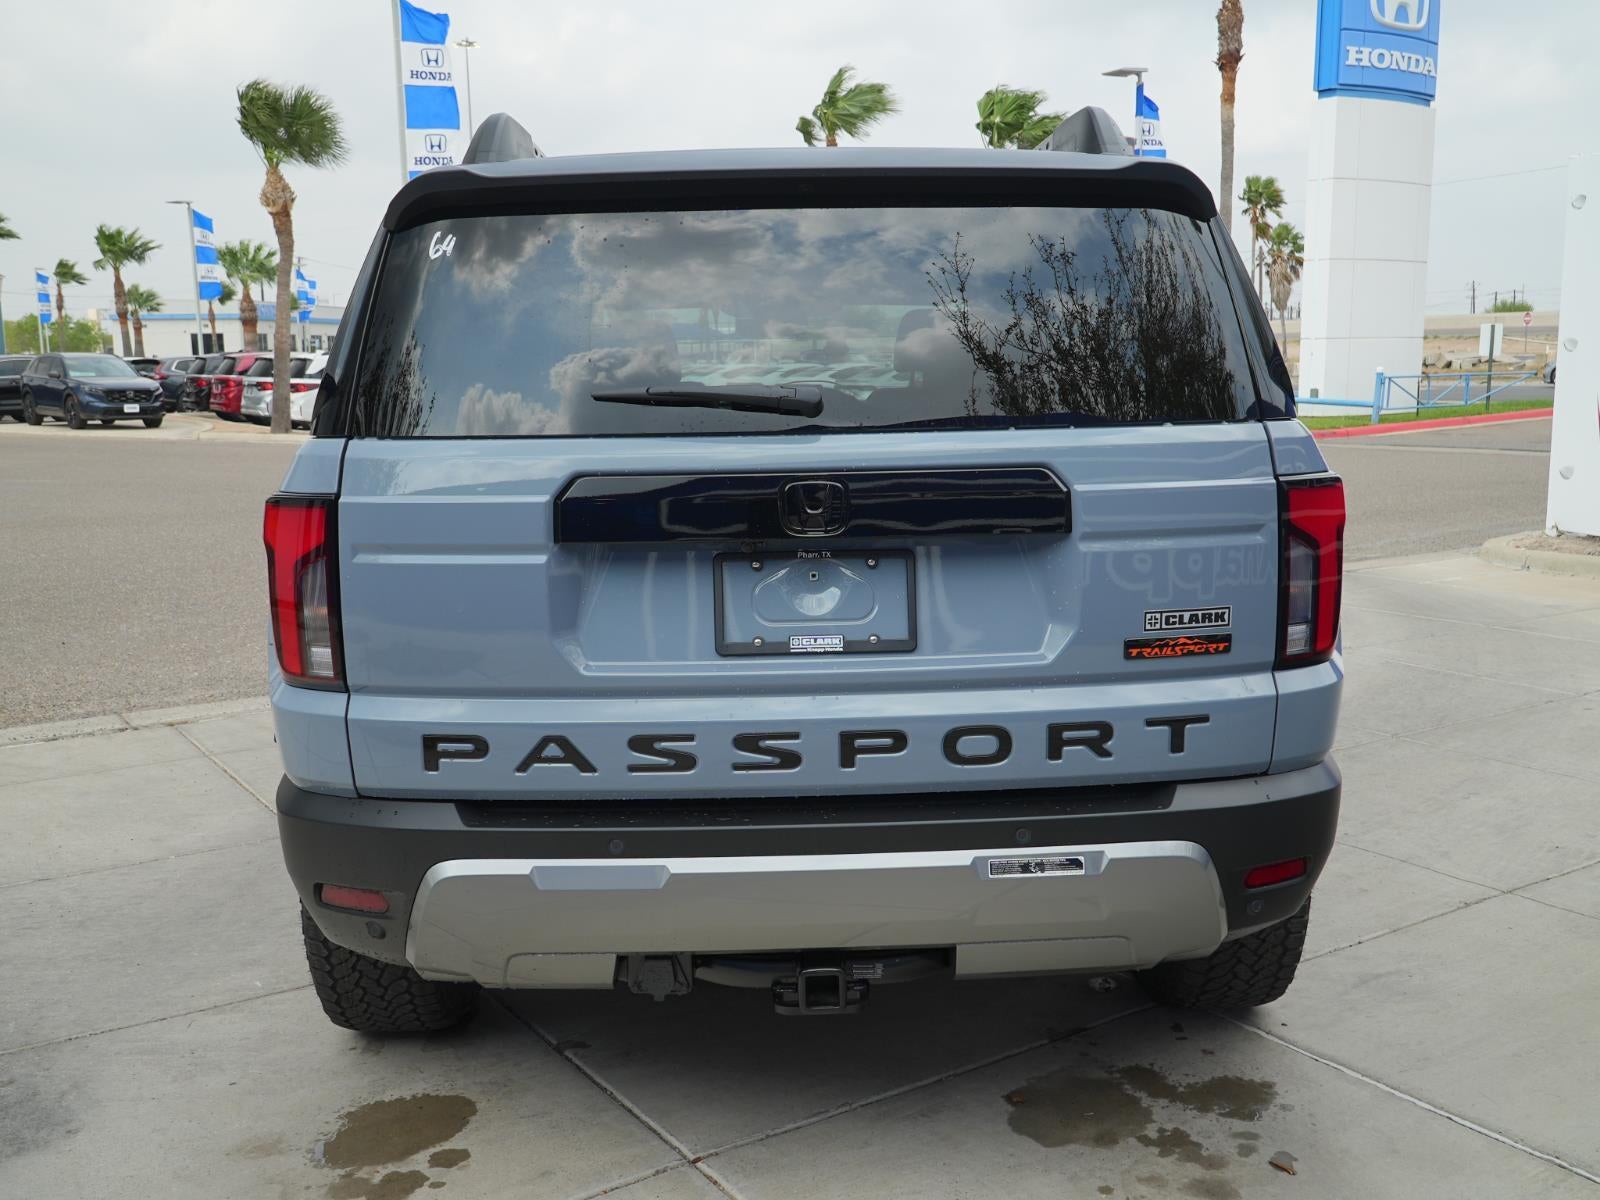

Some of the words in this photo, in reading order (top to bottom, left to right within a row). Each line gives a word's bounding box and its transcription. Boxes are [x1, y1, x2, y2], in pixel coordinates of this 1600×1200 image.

[1345, 46, 1437, 77] HONDA
[428, 230, 456, 260] 64
[821, 551, 832, 559] TX
[1164, 610, 1227, 627] CLARK
[802, 637, 841, 646] CLARK
[1128, 642, 1229, 658] TRAILSPORT
[421, 713, 1210, 776] PASSPORT
